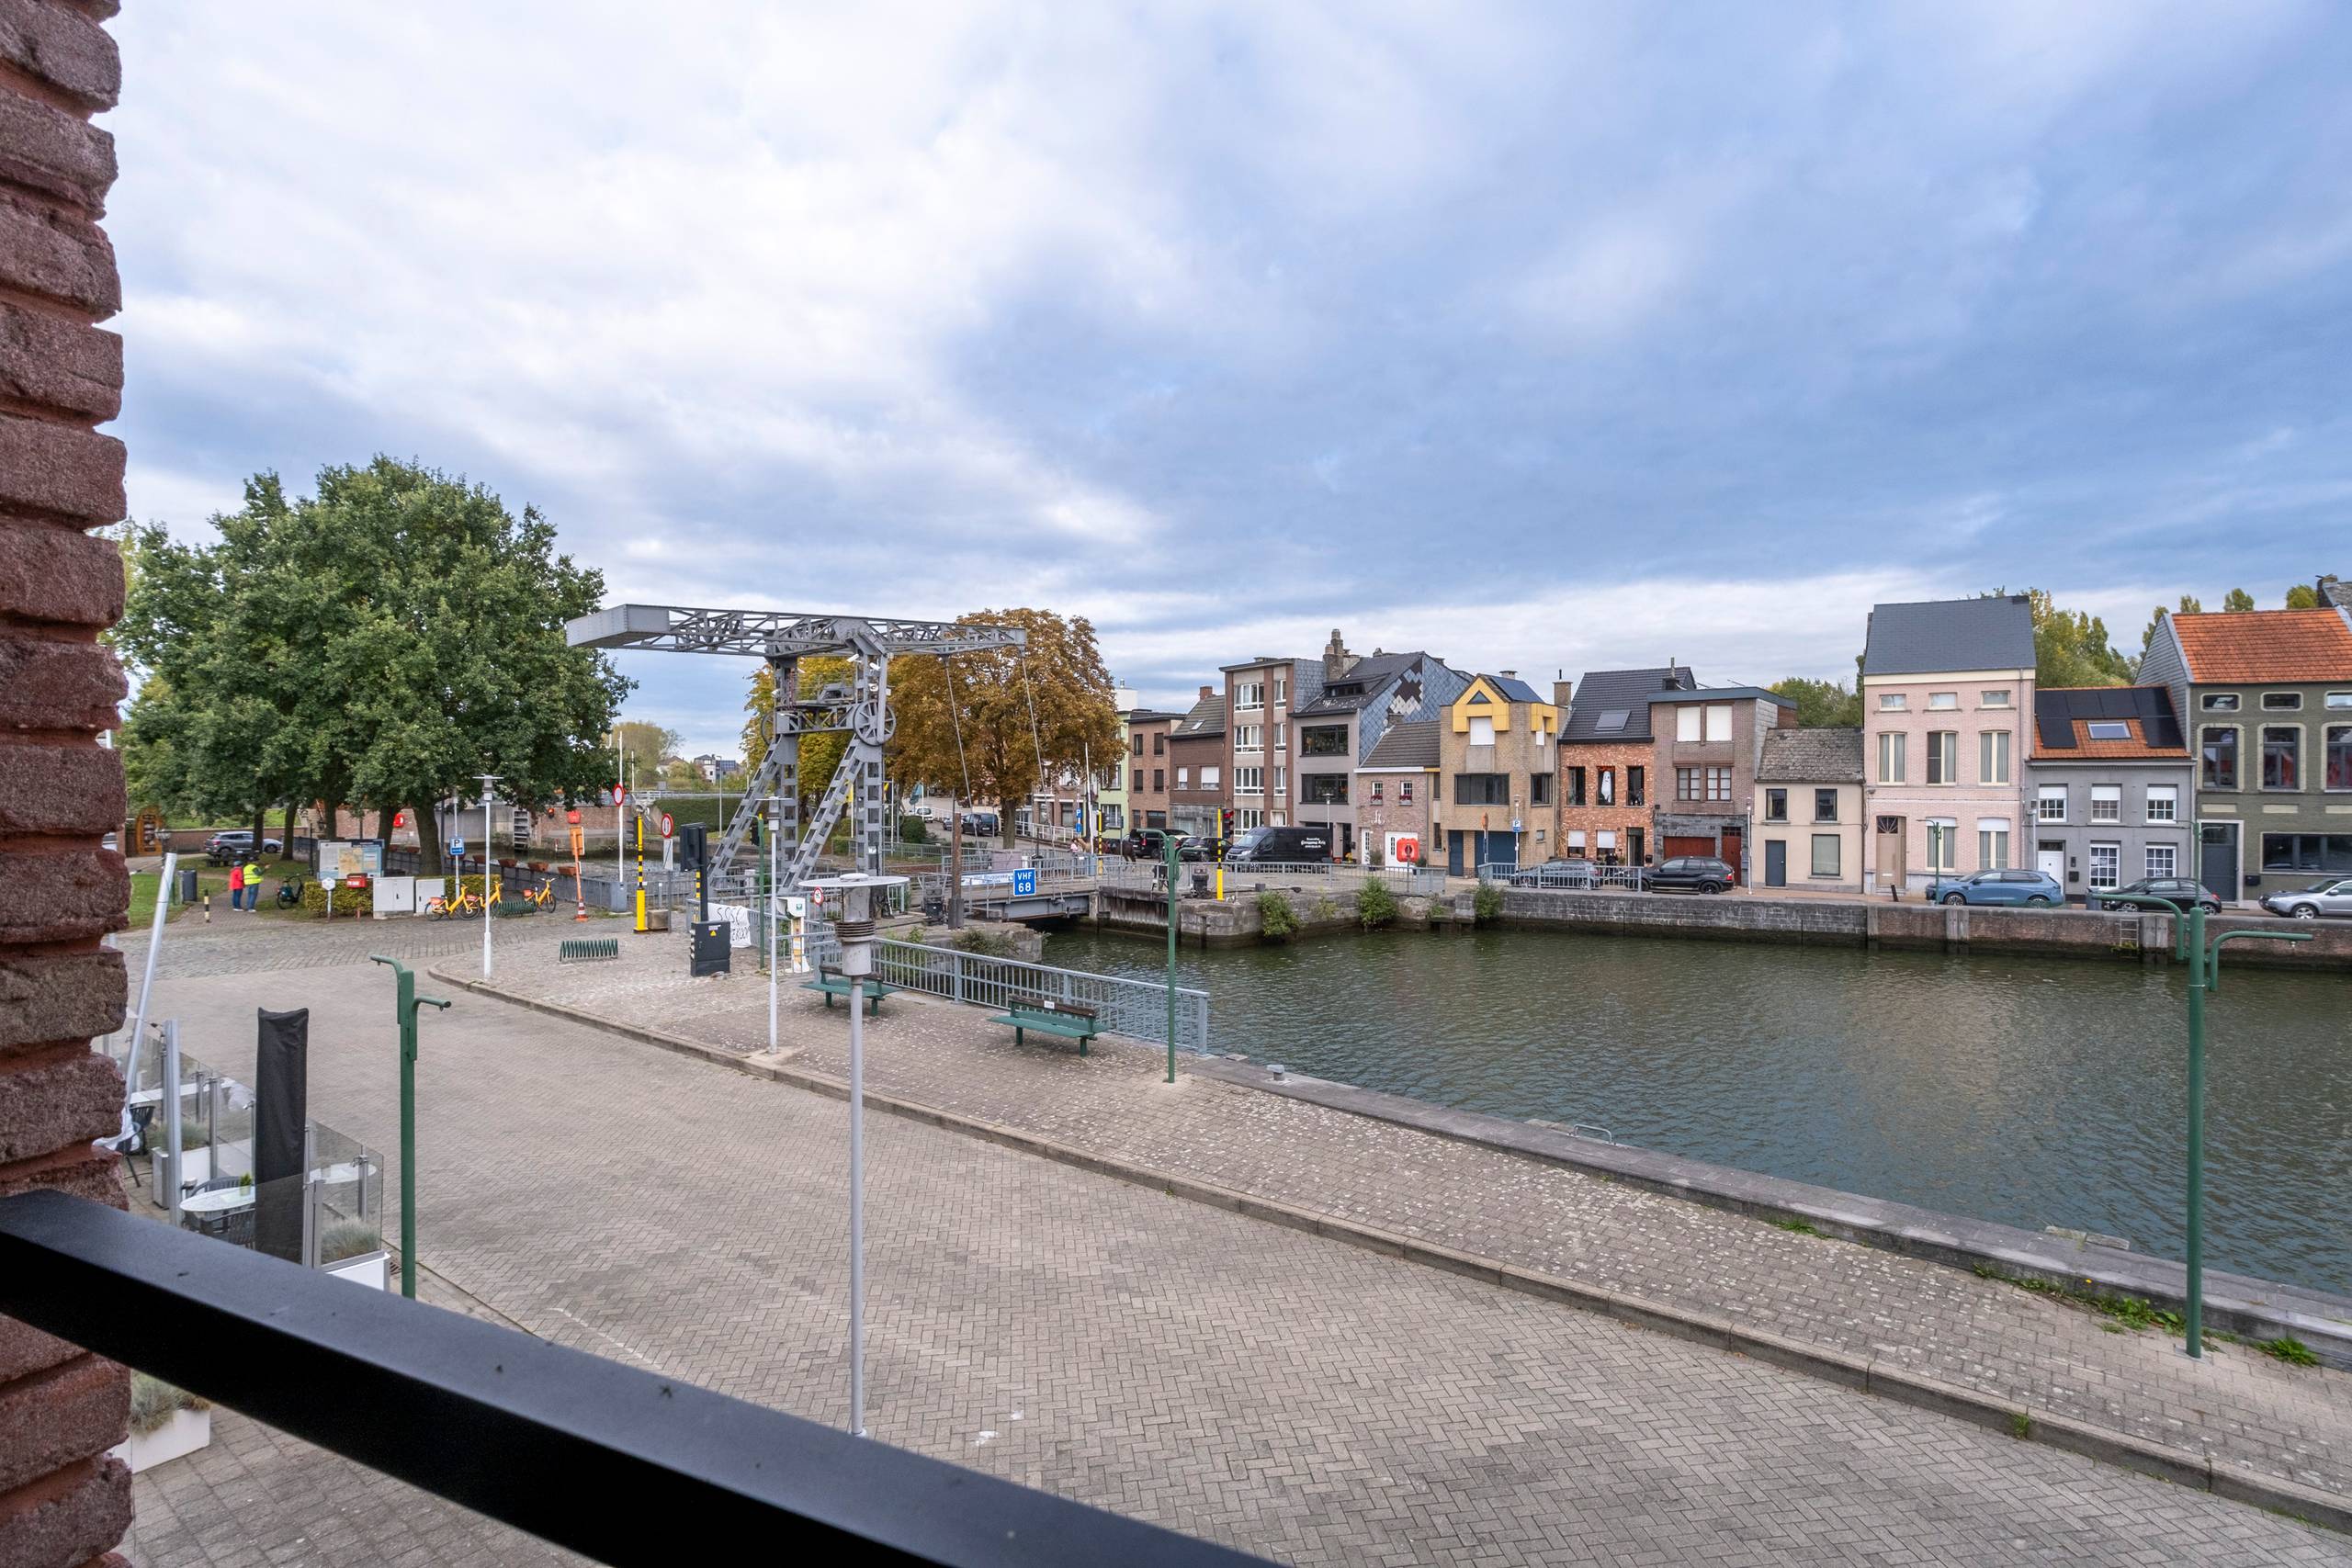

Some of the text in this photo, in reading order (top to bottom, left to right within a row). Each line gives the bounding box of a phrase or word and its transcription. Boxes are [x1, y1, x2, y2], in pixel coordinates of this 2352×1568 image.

[454, 839, 460, 847] P
[1017, 872, 1033, 881] VHF
[1018, 882, 1031, 892] 68
